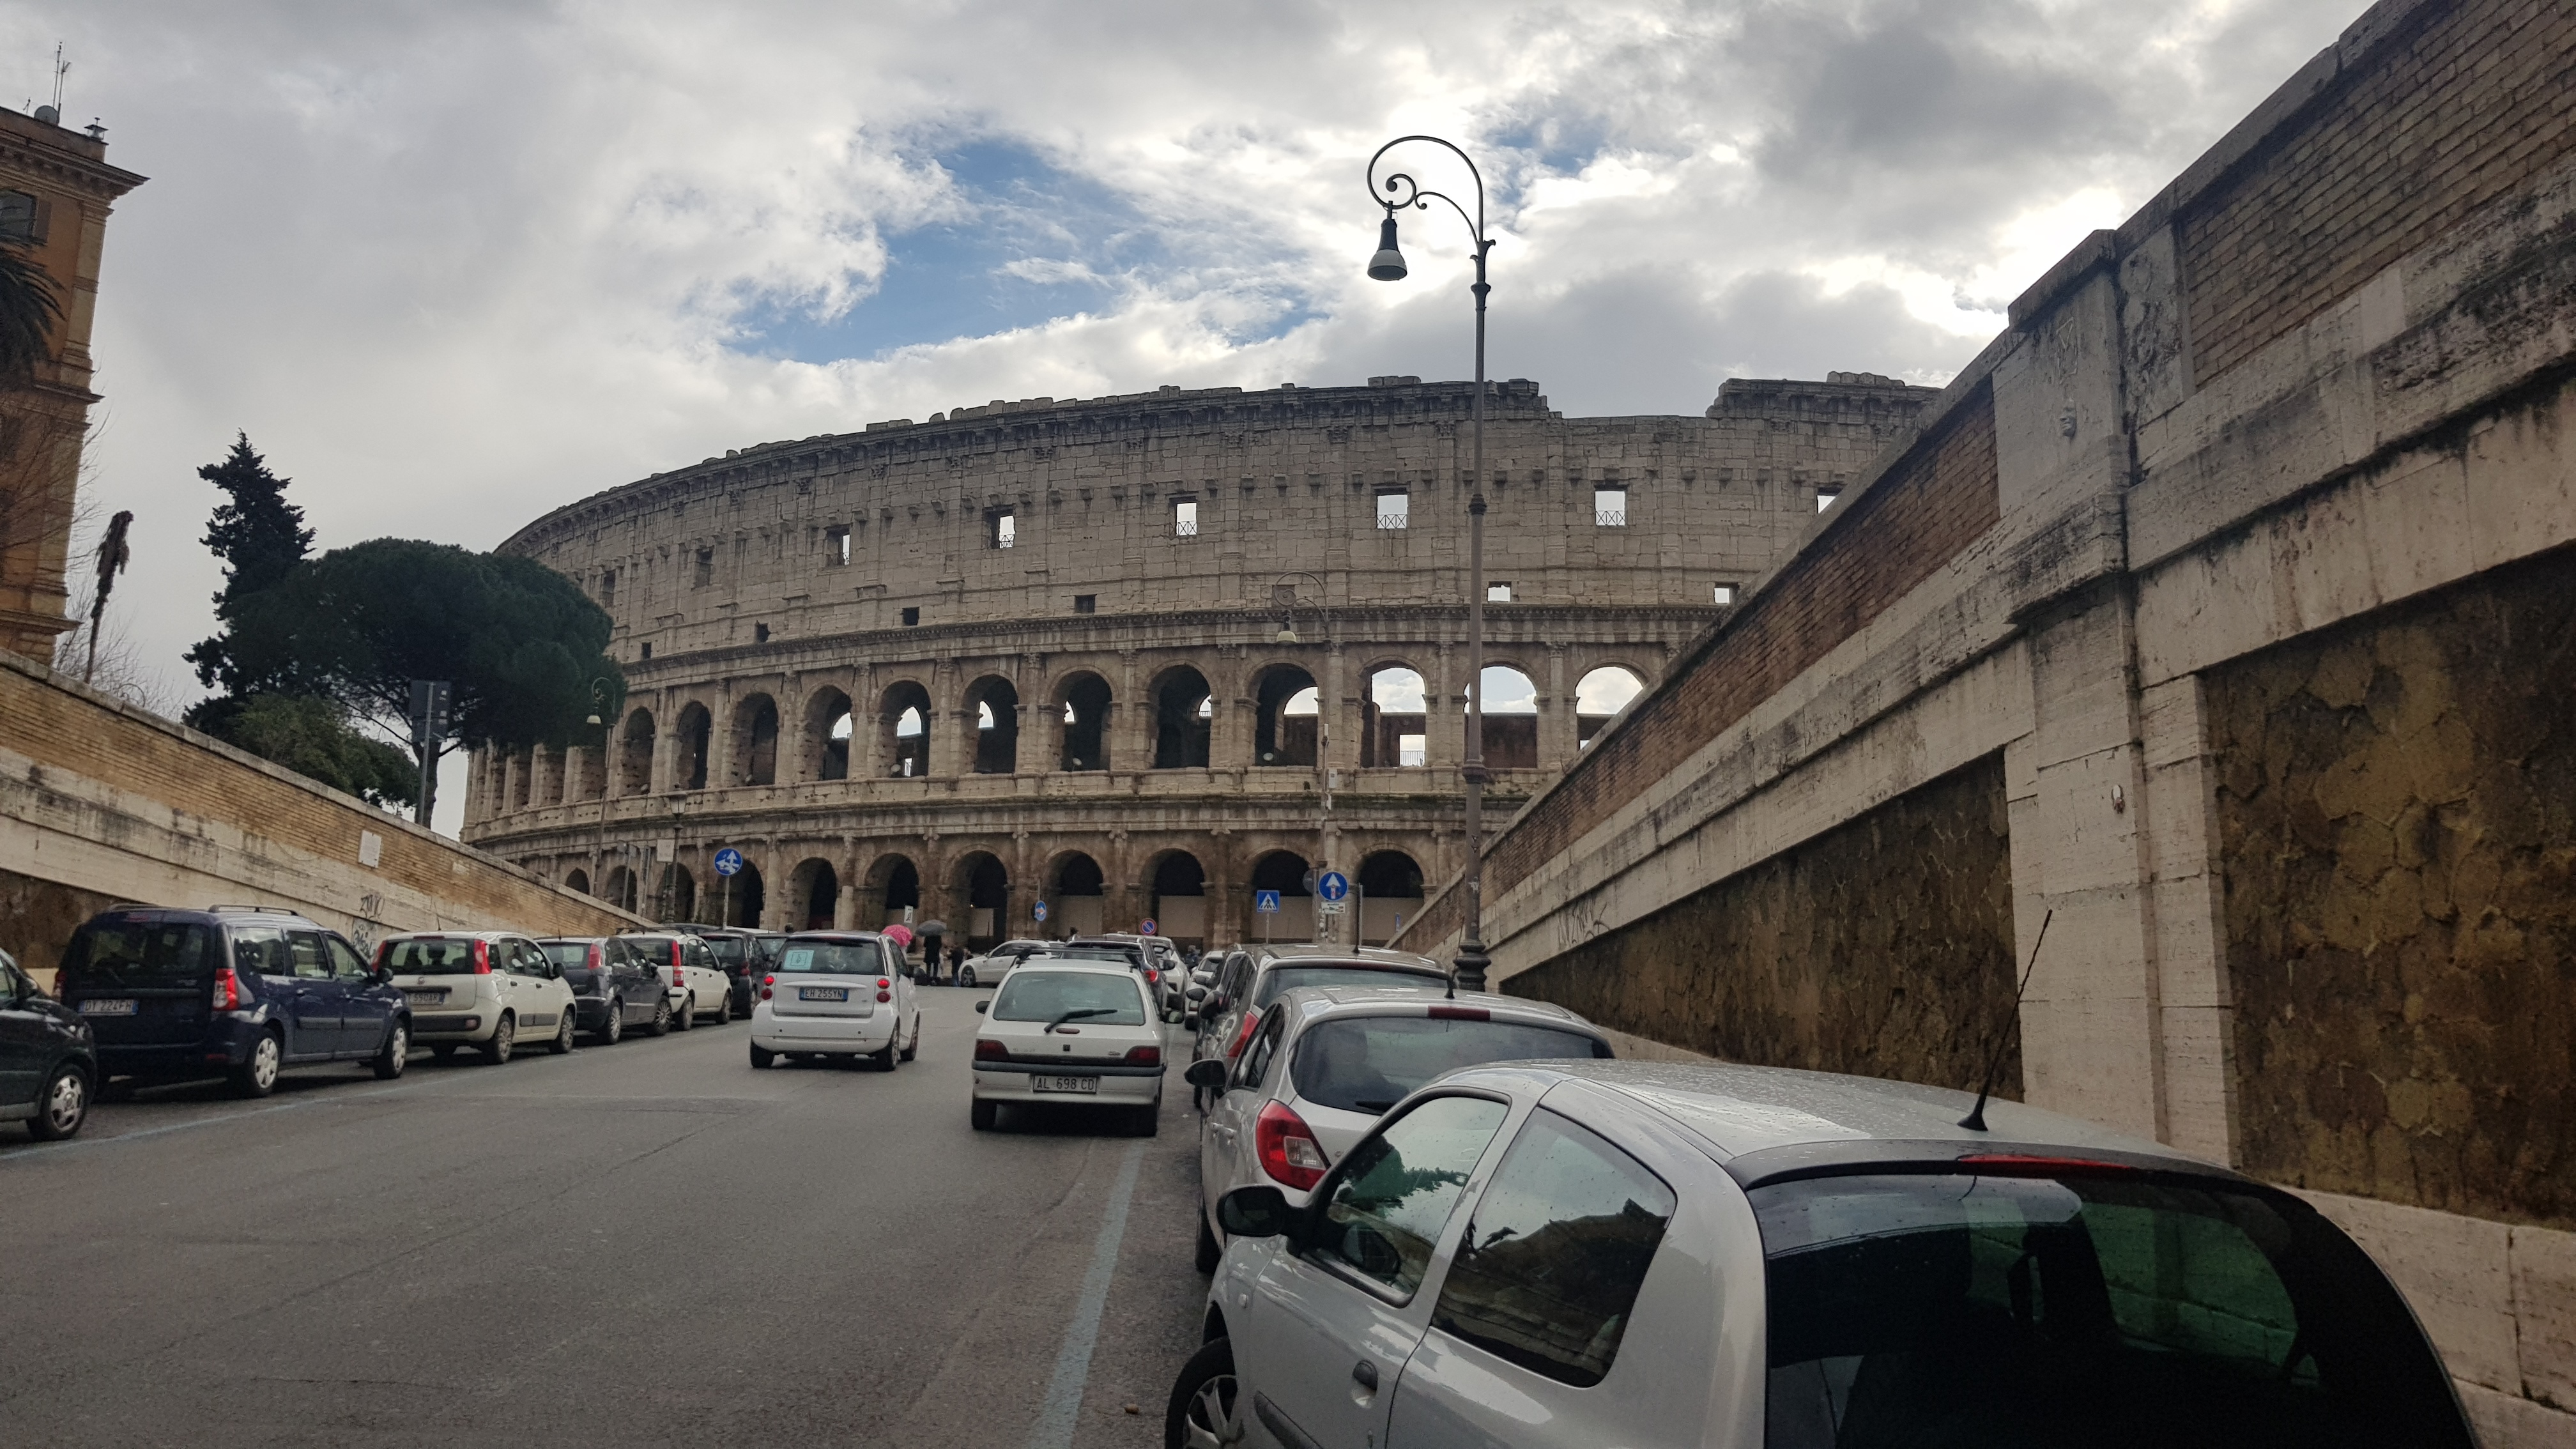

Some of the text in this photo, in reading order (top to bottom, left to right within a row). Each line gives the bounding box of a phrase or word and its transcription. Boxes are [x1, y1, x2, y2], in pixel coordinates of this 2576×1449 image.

[805, 988, 815, 997] EH
[1036, 1077, 1094, 1091] AL 698 CD
